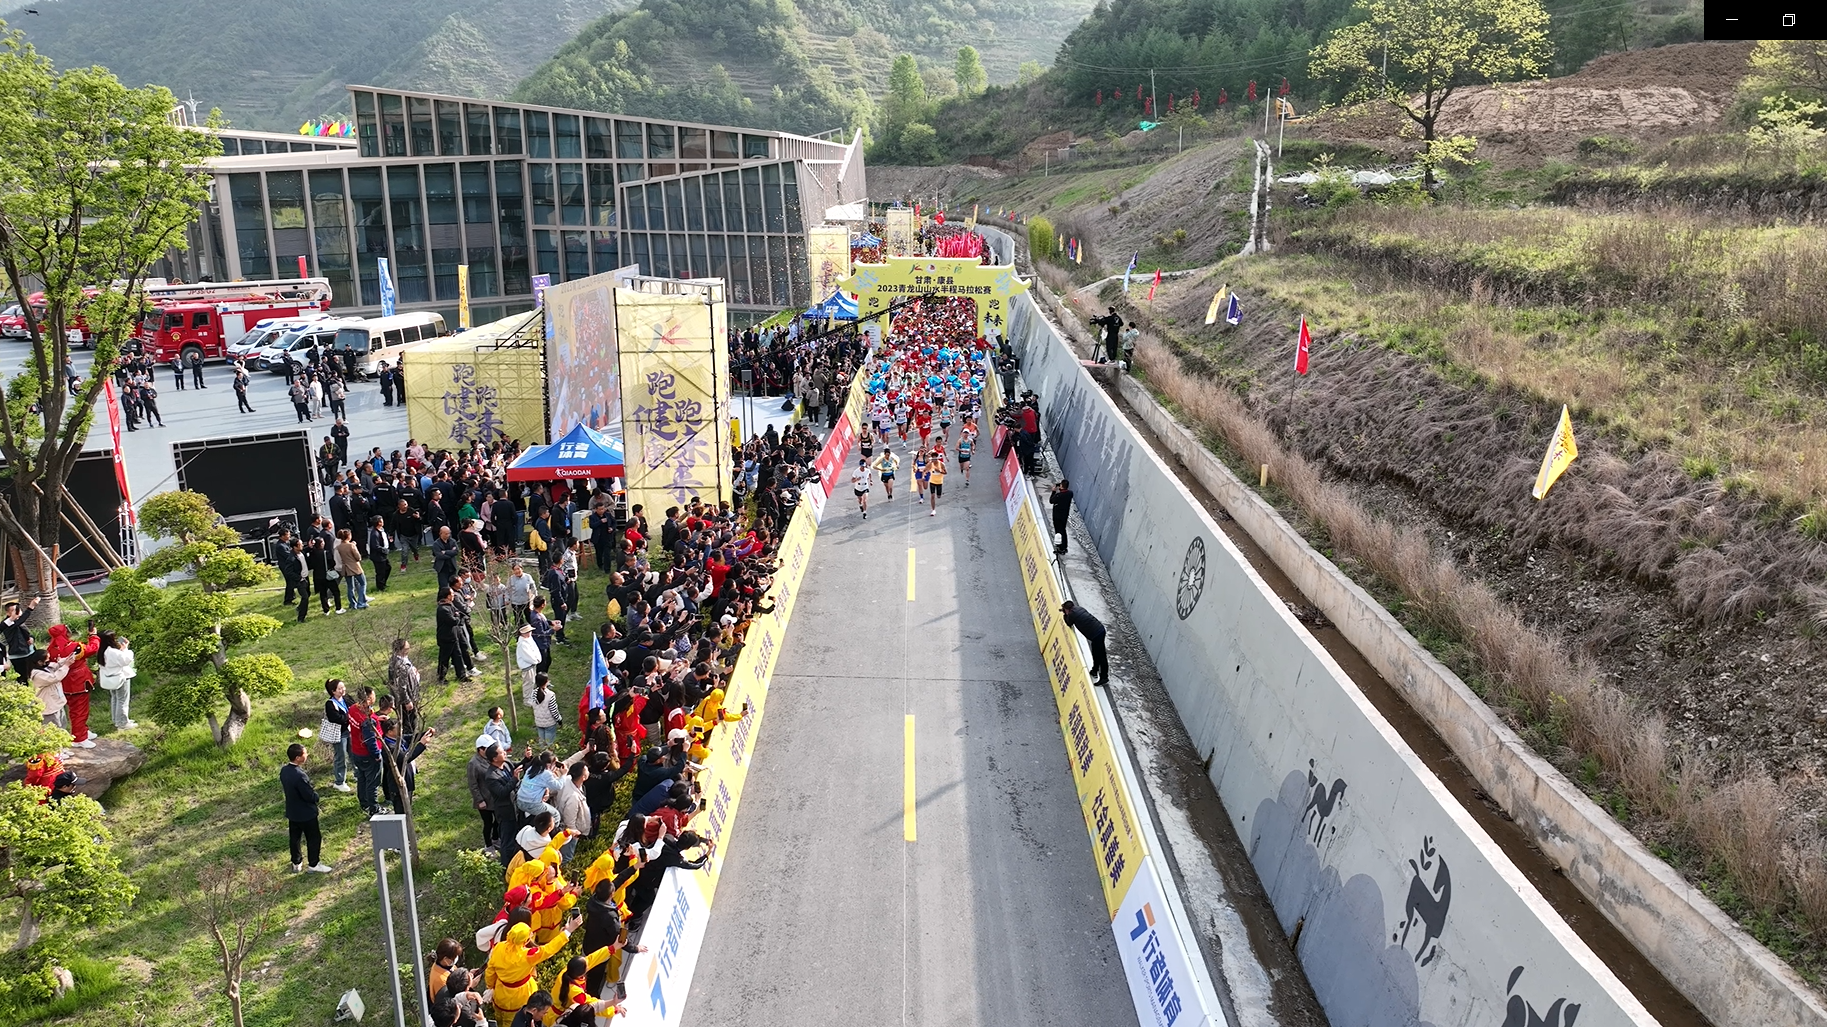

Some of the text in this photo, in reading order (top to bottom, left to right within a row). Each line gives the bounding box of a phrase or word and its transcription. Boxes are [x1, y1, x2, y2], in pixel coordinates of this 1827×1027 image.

[877, 285, 992, 295] 2023青龙山山水半程马拉松赛
[915, 276, 954, 284] 甘肃·康县
[558, 451, 589, 459] 体育
[560, 442, 591, 451] 行者
[561, 469, 592, 477] QIAODAN
[1050, 637, 1071, 697] 产业品质美
[1068, 700, 1094, 778] 城镇精致美
[1091, 787, 1126, 889] 社会真善美
[658, 886, 690, 978] 行者体育
[1142, 930, 1182, 1027] 行者体育
